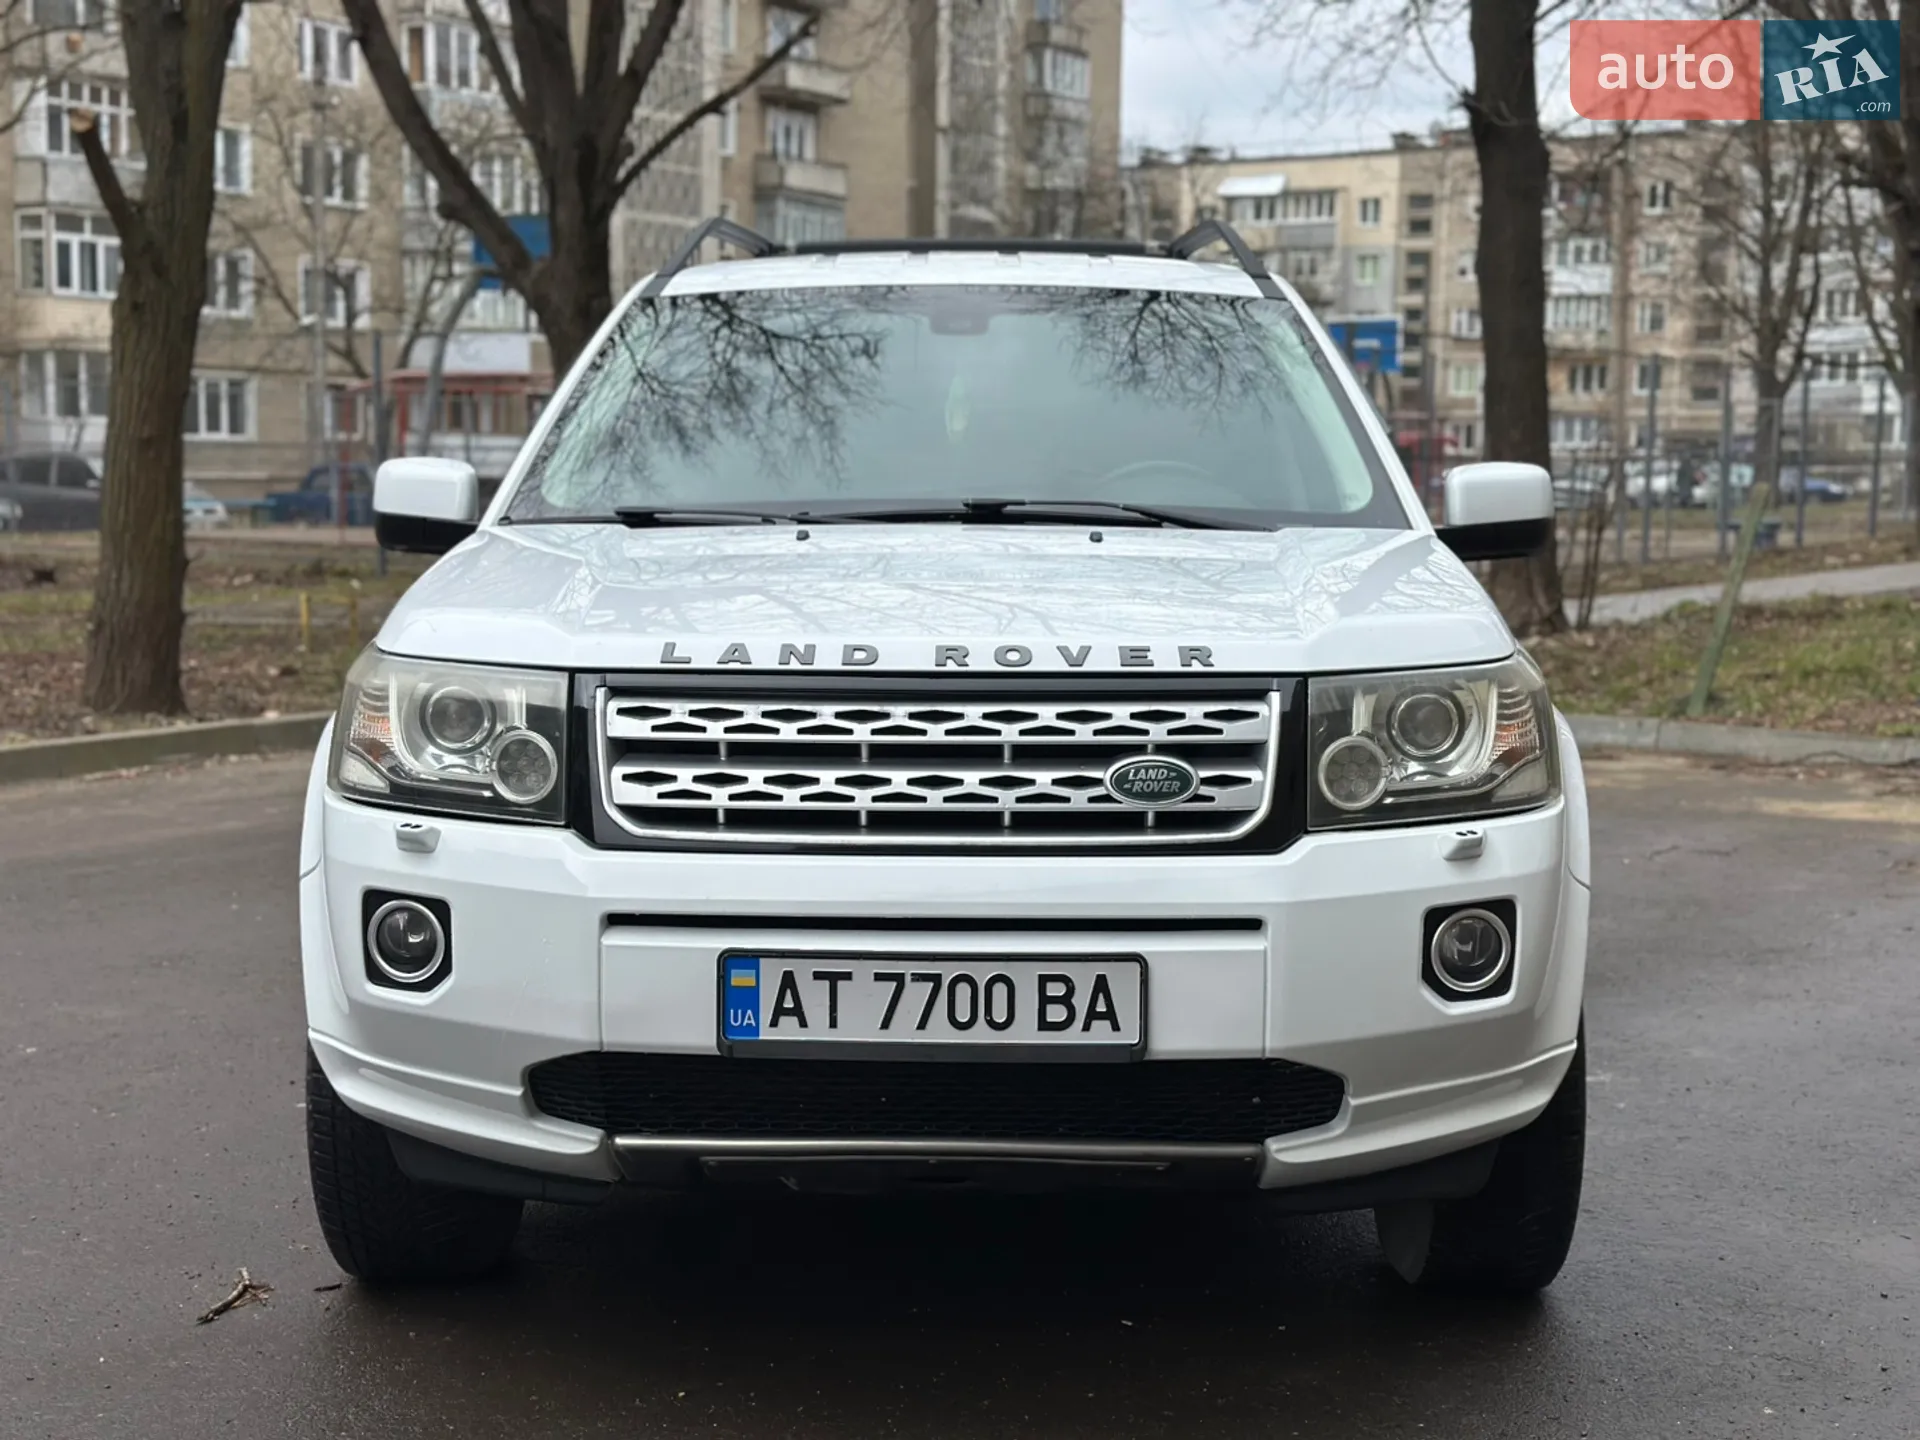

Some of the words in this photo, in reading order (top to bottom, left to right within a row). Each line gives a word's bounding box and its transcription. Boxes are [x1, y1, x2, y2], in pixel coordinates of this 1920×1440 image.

[660, 642, 879, 667] LAND
[934, 644, 1215, 668] ROVER
[768, 970, 853, 1030] AT
[873, 971, 1016, 1031] 7700
[1037, 973, 1121, 1032] BA
[729, 1008, 756, 1028] UA
